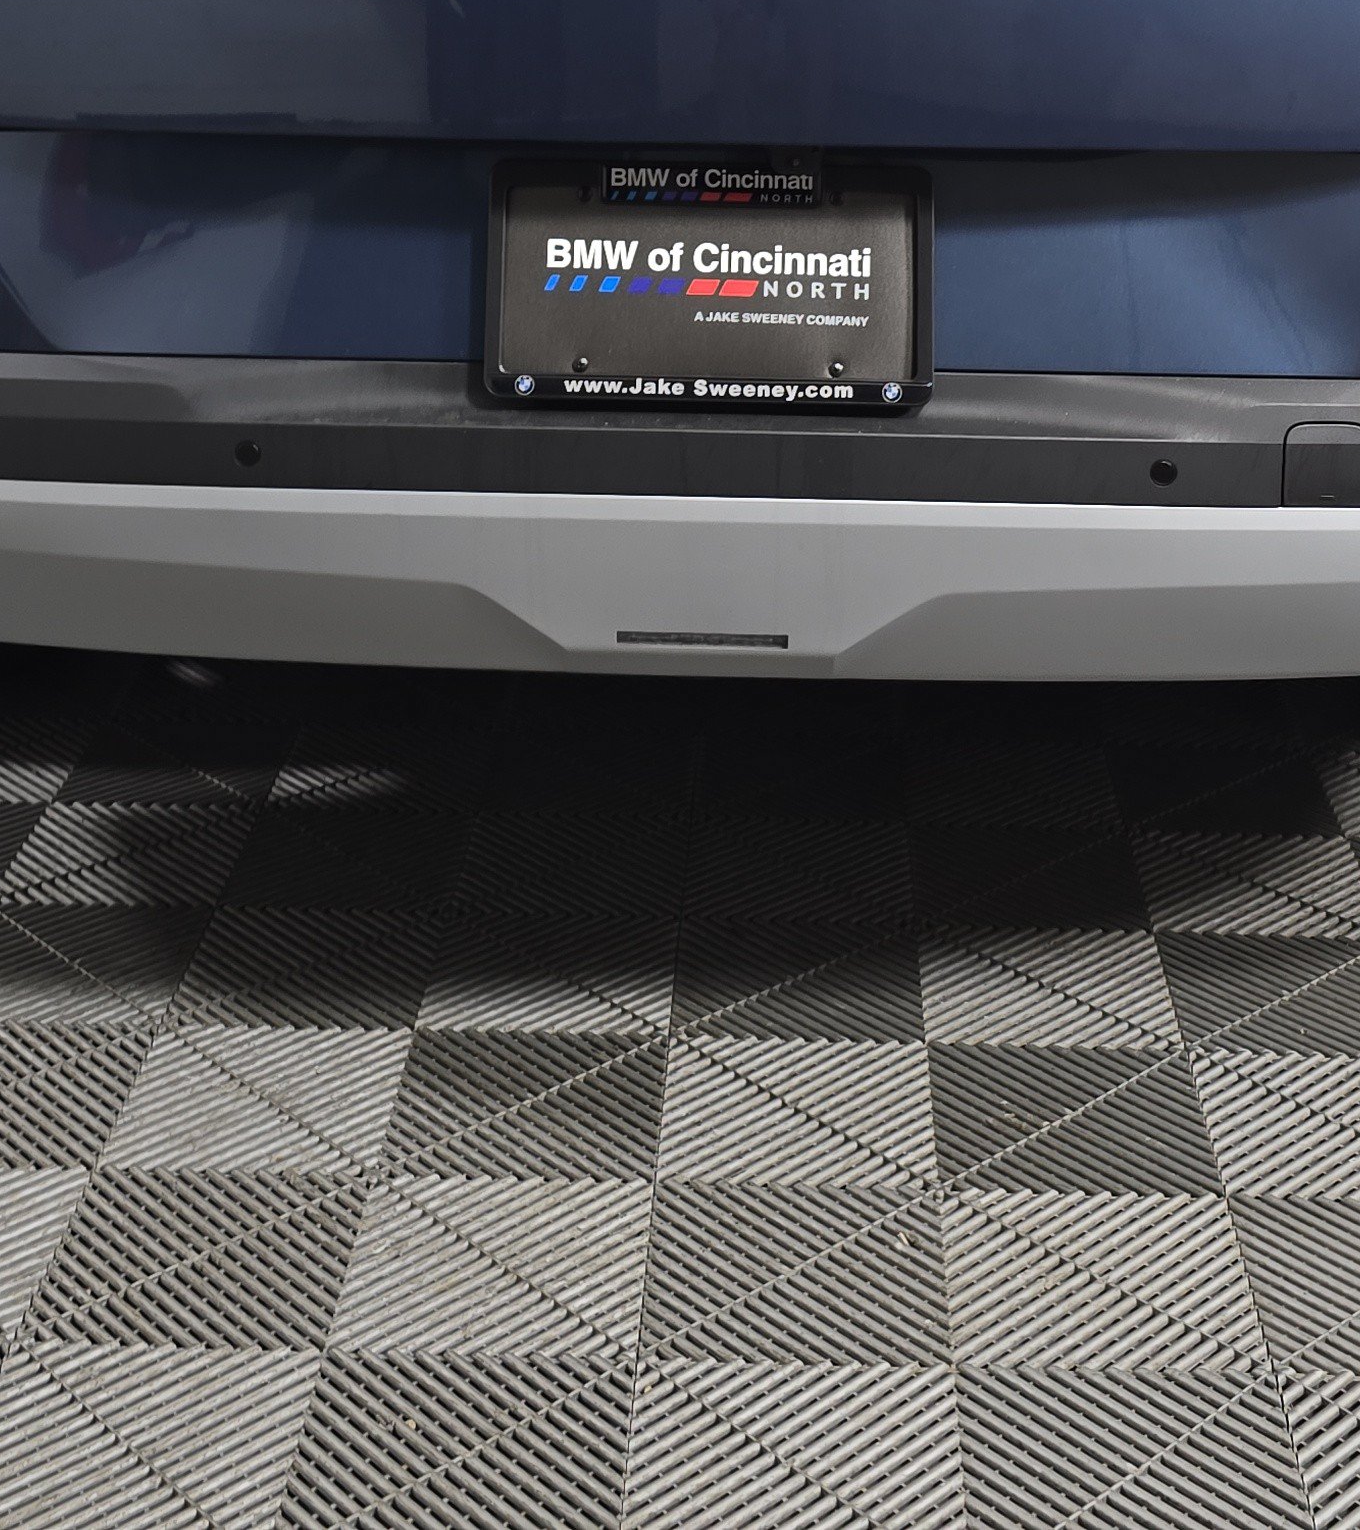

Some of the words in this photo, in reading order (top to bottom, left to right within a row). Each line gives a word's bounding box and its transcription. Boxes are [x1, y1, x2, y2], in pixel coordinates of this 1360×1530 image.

[610, 167, 671, 188] BMW
[676, 169, 699, 188] of
[704, 168, 814, 191] Cincinnati
[759, 193, 814, 204] NORTH
[546, 238, 638, 270] BMW
[647, 242, 684, 272] of
[693, 242, 872, 277] Cincinnati
[763, 279, 871, 300] NORTH
[693, 311, 705, 322] A
[705, 311, 740, 323] JAKE
[741, 312, 804, 325] SWEENEY
[806, 314, 870, 327] COMPANY
[564, 378, 685, 396] www.Jake
[693, 378, 854, 401] Sweeney.com
